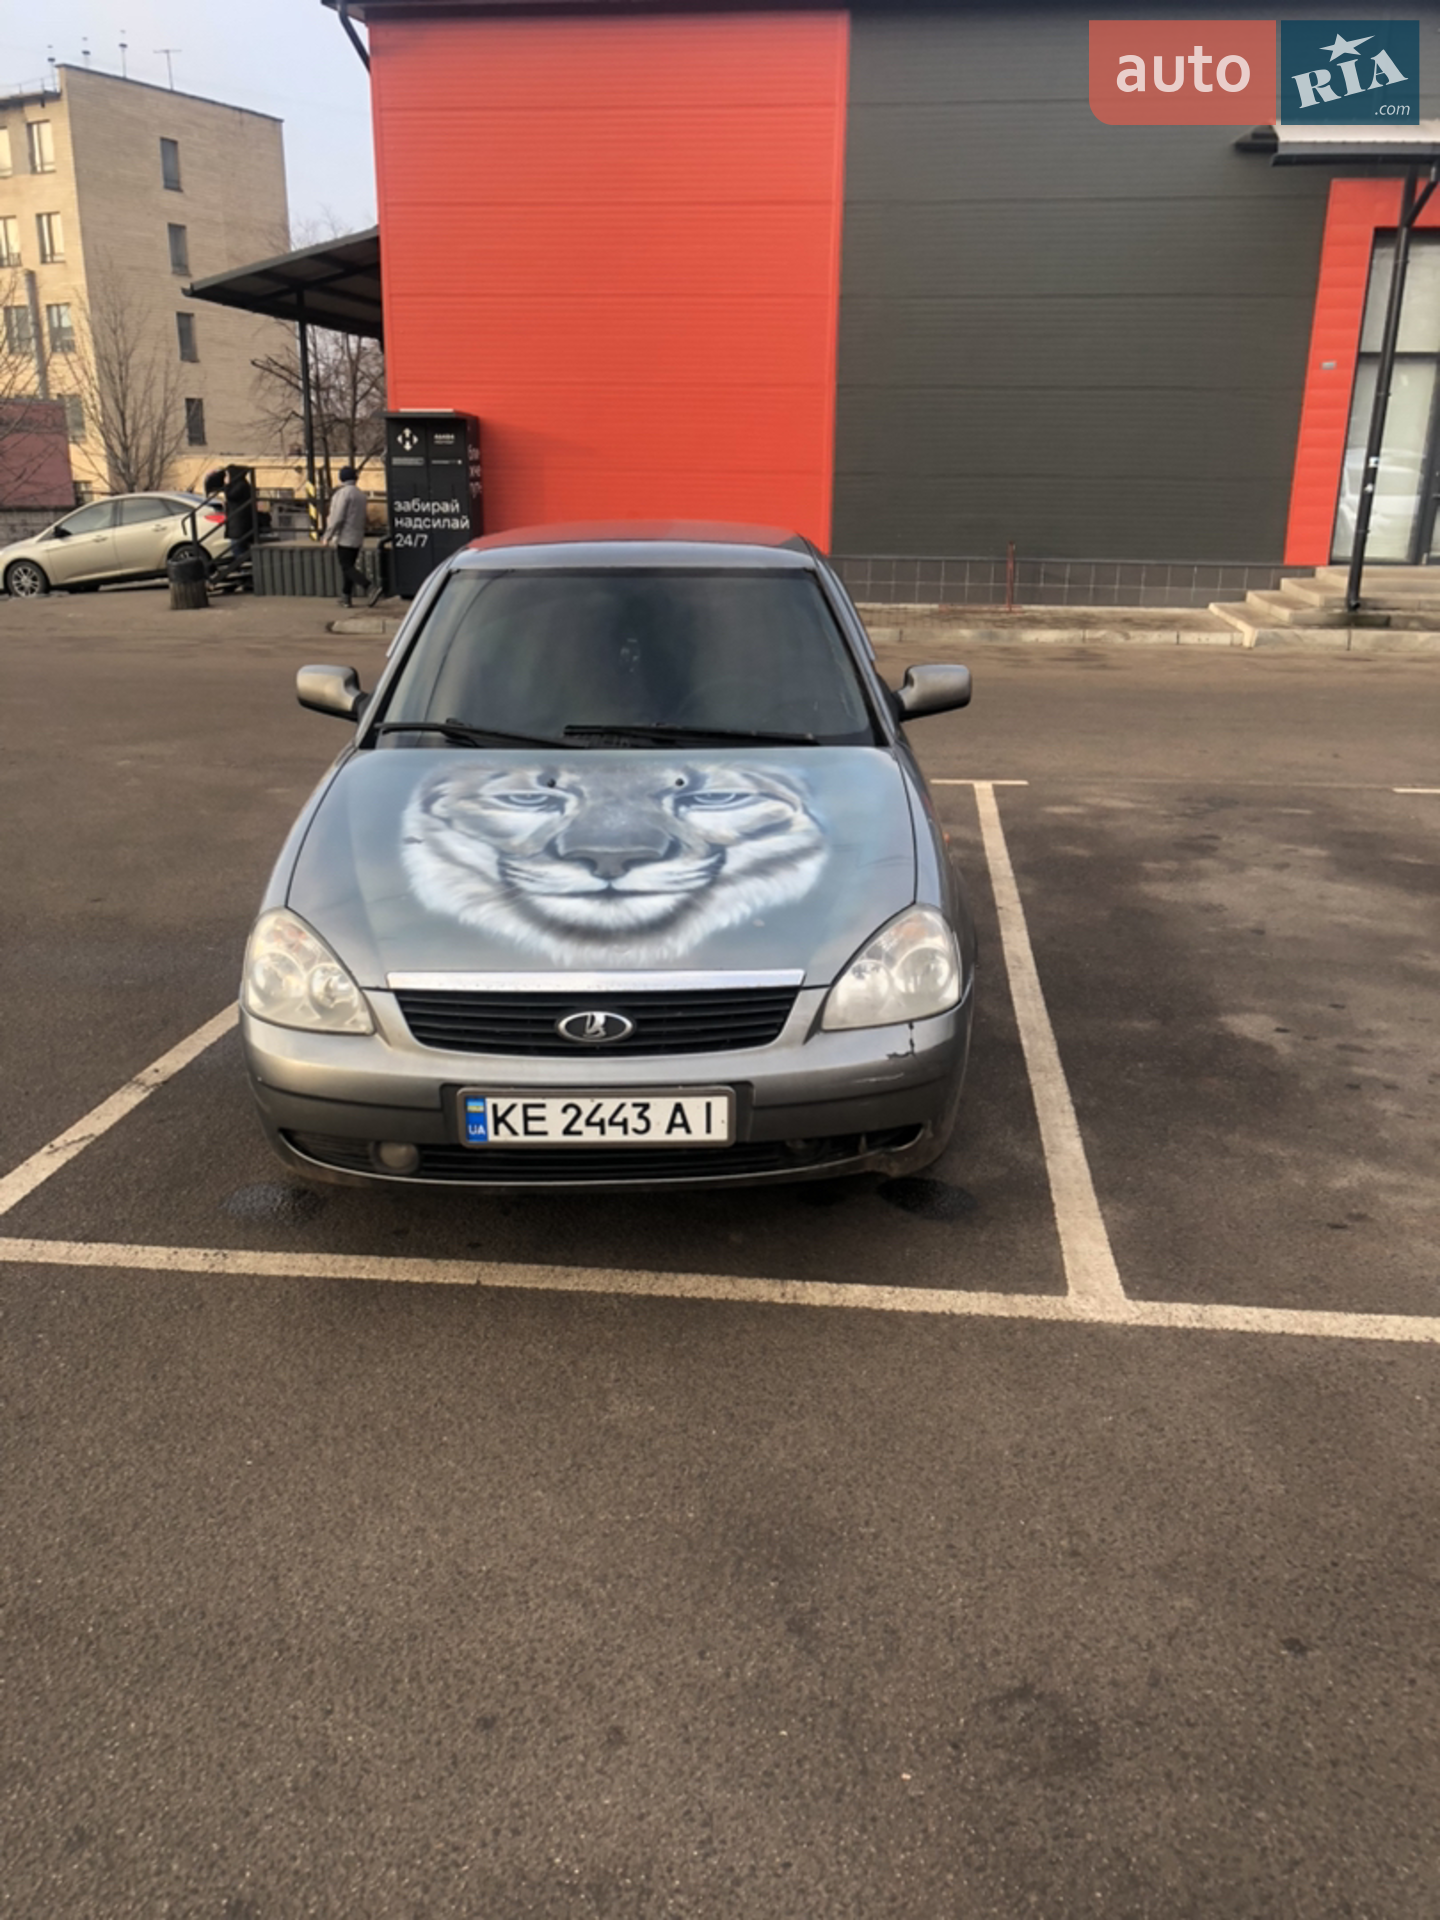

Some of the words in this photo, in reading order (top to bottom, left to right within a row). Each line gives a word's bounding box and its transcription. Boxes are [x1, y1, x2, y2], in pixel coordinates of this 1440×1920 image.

[393, 498, 460, 515] забирай
[394, 516, 470, 529] надсилай
[395, 533, 428, 547] 24/7
[491, 1103, 549, 1136] KE
[560, 1103, 651, 1136] 2443
[468, 1124, 486, 1136] UA
